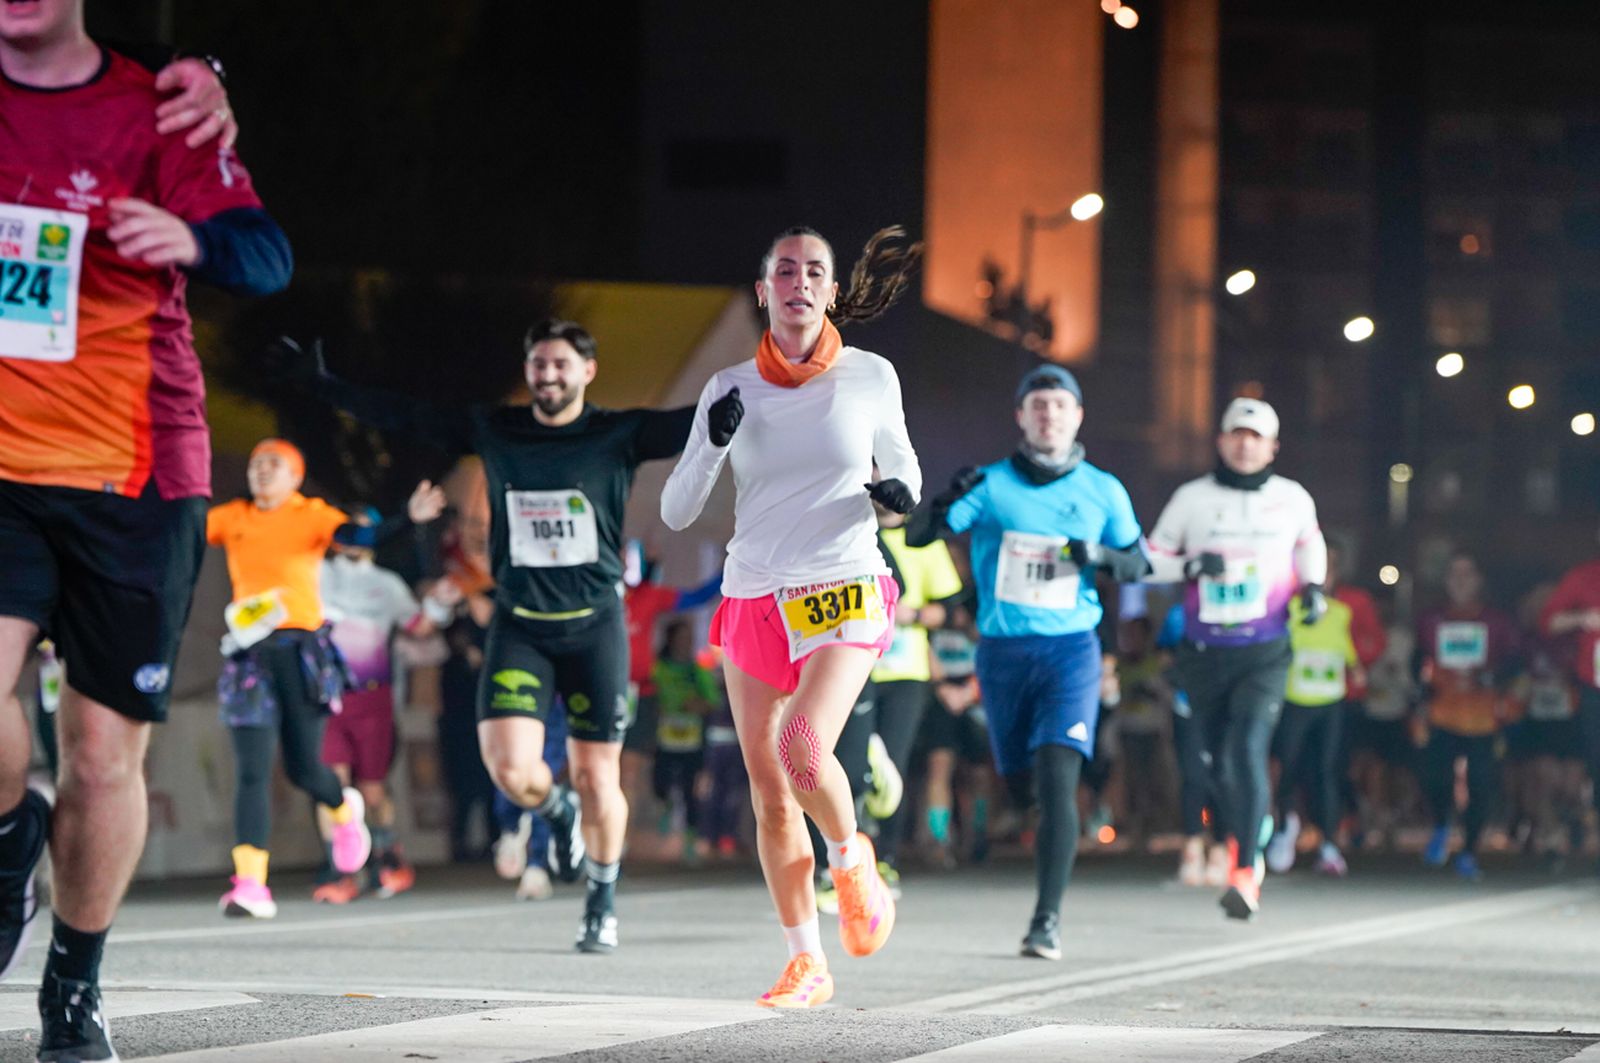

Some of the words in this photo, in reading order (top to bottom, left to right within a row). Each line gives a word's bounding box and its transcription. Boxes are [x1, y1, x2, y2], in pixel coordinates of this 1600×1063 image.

[532, 519, 574, 539] 1041
[787, 583, 808, 600] SAN
[804, 583, 862, 625] 3317
